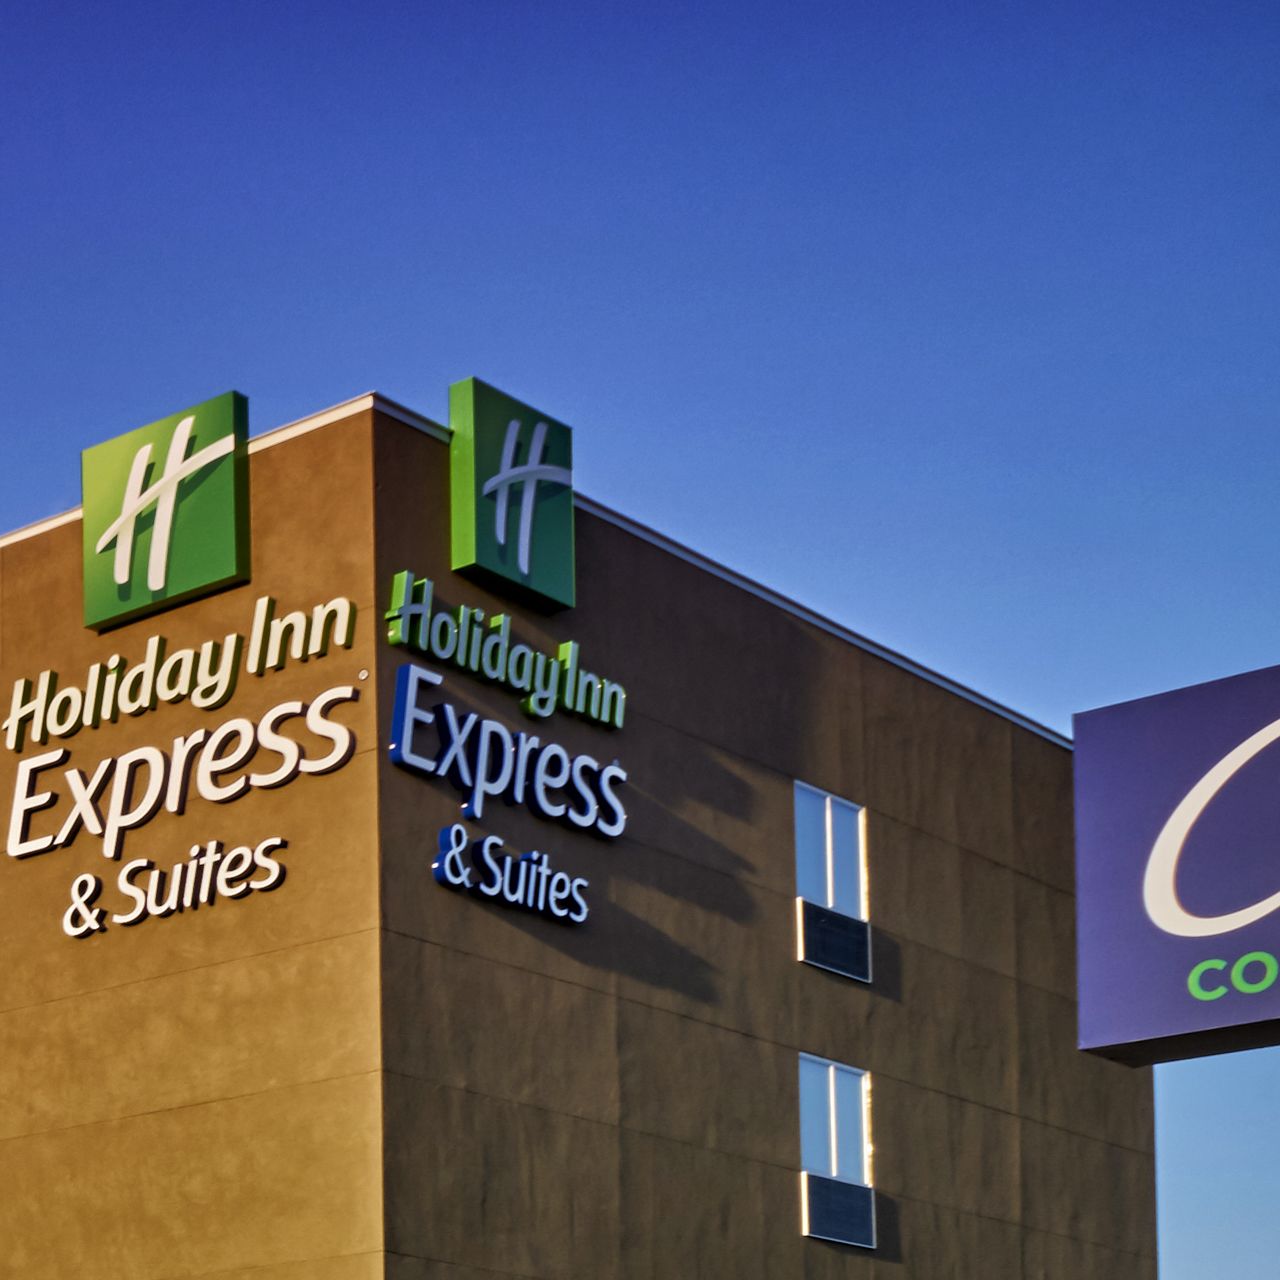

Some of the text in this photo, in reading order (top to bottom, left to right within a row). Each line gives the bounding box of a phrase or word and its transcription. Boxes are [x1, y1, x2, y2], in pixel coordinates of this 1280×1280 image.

[2, 596, 354, 751] Holiday Inn
[385, 570, 626, 729] Holiday Inn
[6, 685, 358, 859] Express
[389, 664, 628, 837] Express
[62, 836, 286, 937] & Suites
[434, 823, 590, 924] & Suites
